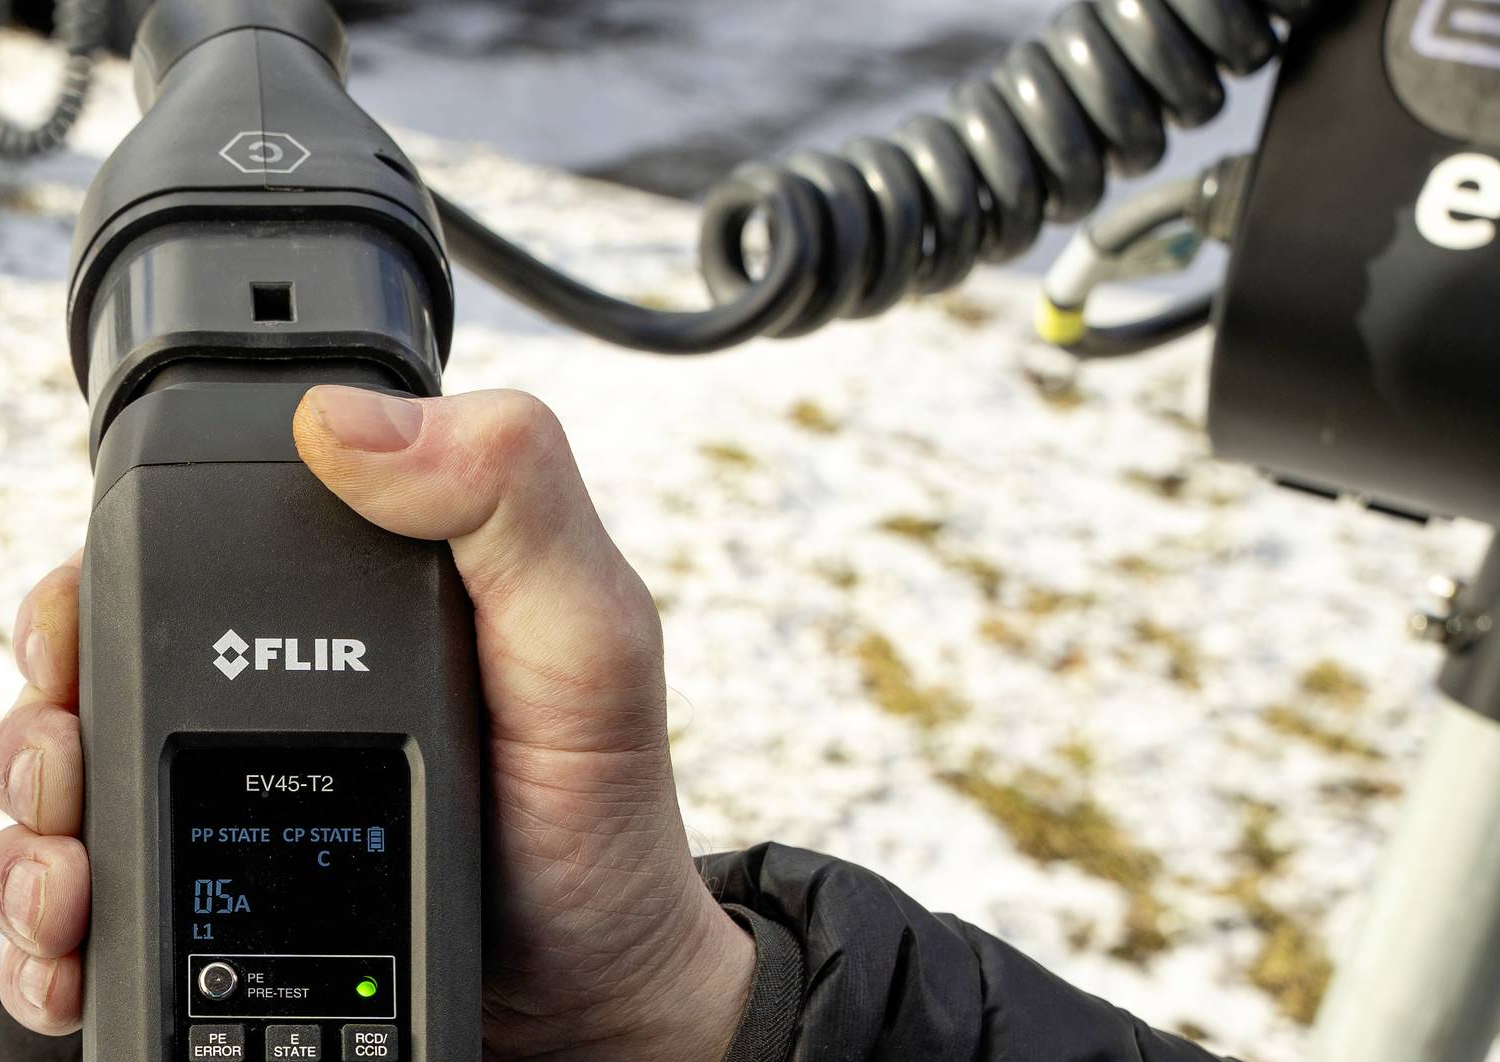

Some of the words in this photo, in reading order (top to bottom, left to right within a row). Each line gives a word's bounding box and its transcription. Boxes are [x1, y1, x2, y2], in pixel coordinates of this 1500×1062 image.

[255, 638, 370, 671] FLIR
[247, 775, 333, 791] EV45-T2
[192, 828, 213, 842] PP
[219, 828, 270, 842] STATE
[283, 828, 305, 842] CP
[311, 828, 361, 842] STATE
[318, 851, 330, 867] C
[193, 923, 214, 939] L1
[248, 973, 264, 983] PE
[248, 988, 309, 998] PRE-TEST
[210, 1033, 226, 1044] PE
[291, 1034, 299, 1044] E
[356, 1033, 388, 1046] RCD/
[195, 1046, 241, 1056] ERROR
[274, 1046, 316, 1057] STATE
[356, 1046, 387, 1056] CCID
